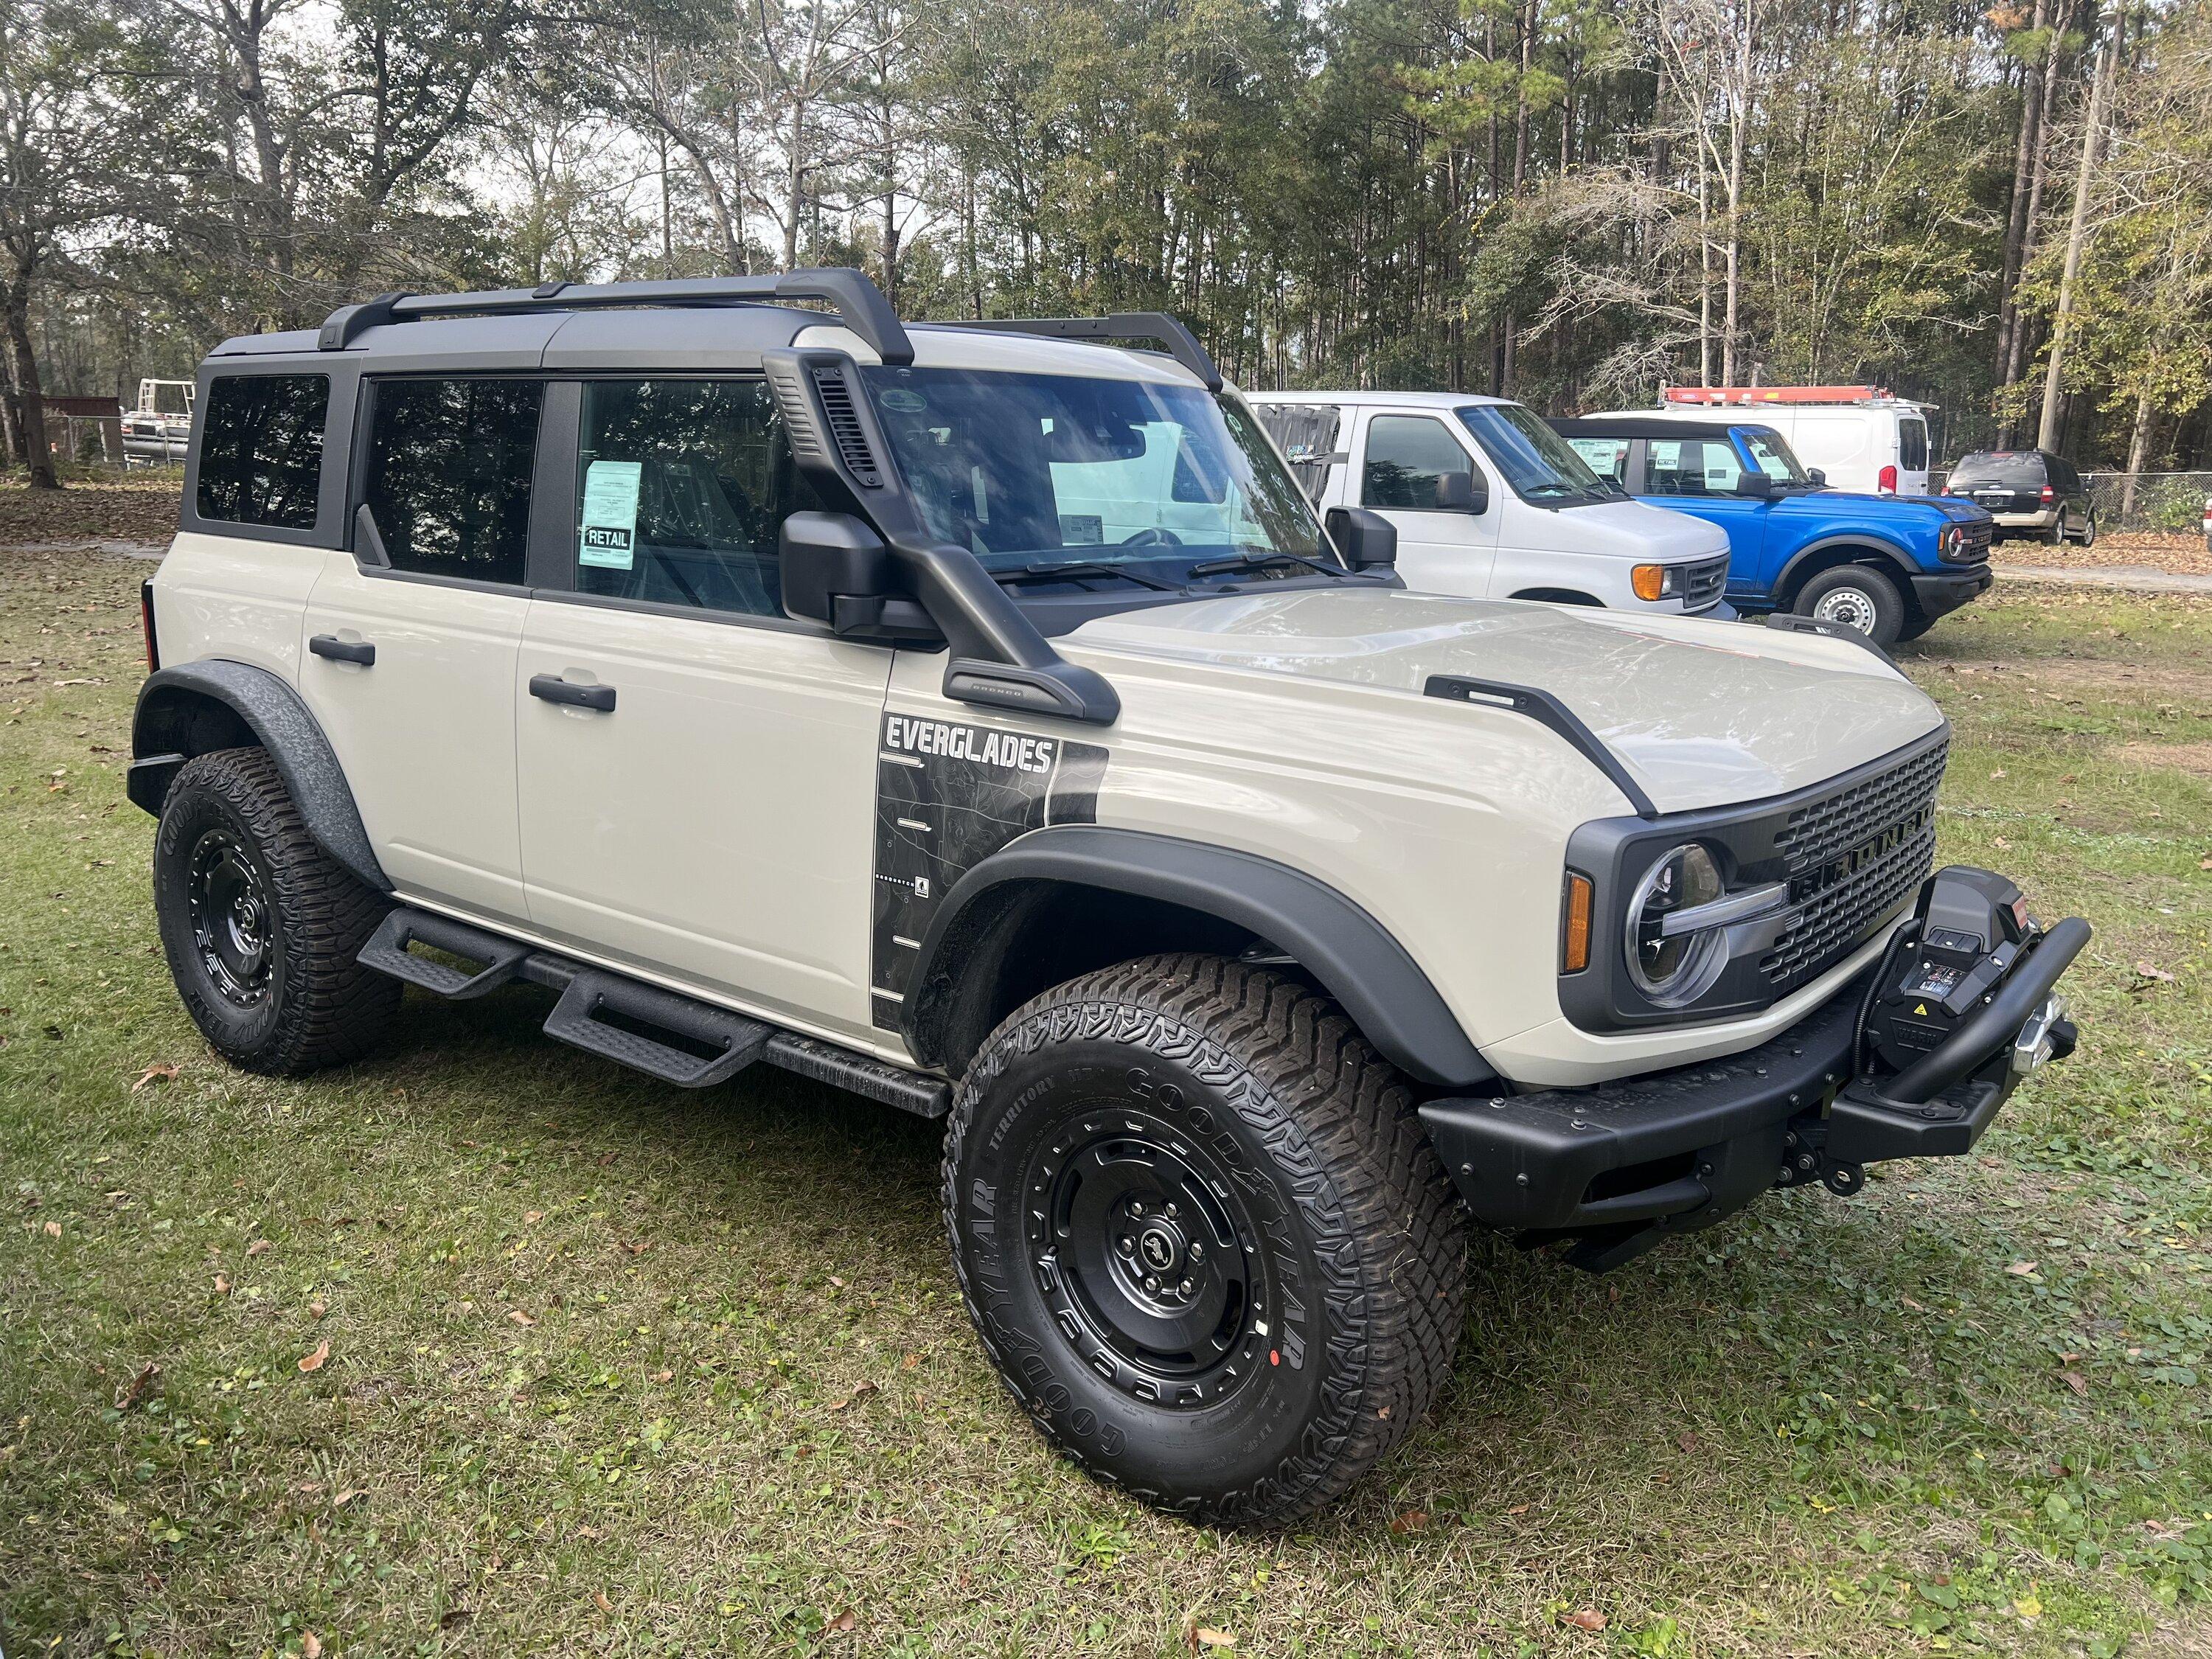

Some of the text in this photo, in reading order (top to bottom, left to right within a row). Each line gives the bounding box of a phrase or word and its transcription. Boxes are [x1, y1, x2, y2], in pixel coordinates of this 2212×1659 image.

[588, 529, 627, 547] RETAIL
[973, 684, 1023, 698] BRONCO
[886, 715, 1053, 774] EVERGLADES
[874, 873, 915, 888] SASQUATCH
[1789, 797, 1935, 905] BRONCO
[1897, 1026, 1937, 1046] WARN
[988, 1074, 1057, 1152] TERRITORY
[1125, 1067, 1306, 1371] GOODYEAR
[970, 1178, 1128, 1458] GOODYEAR
